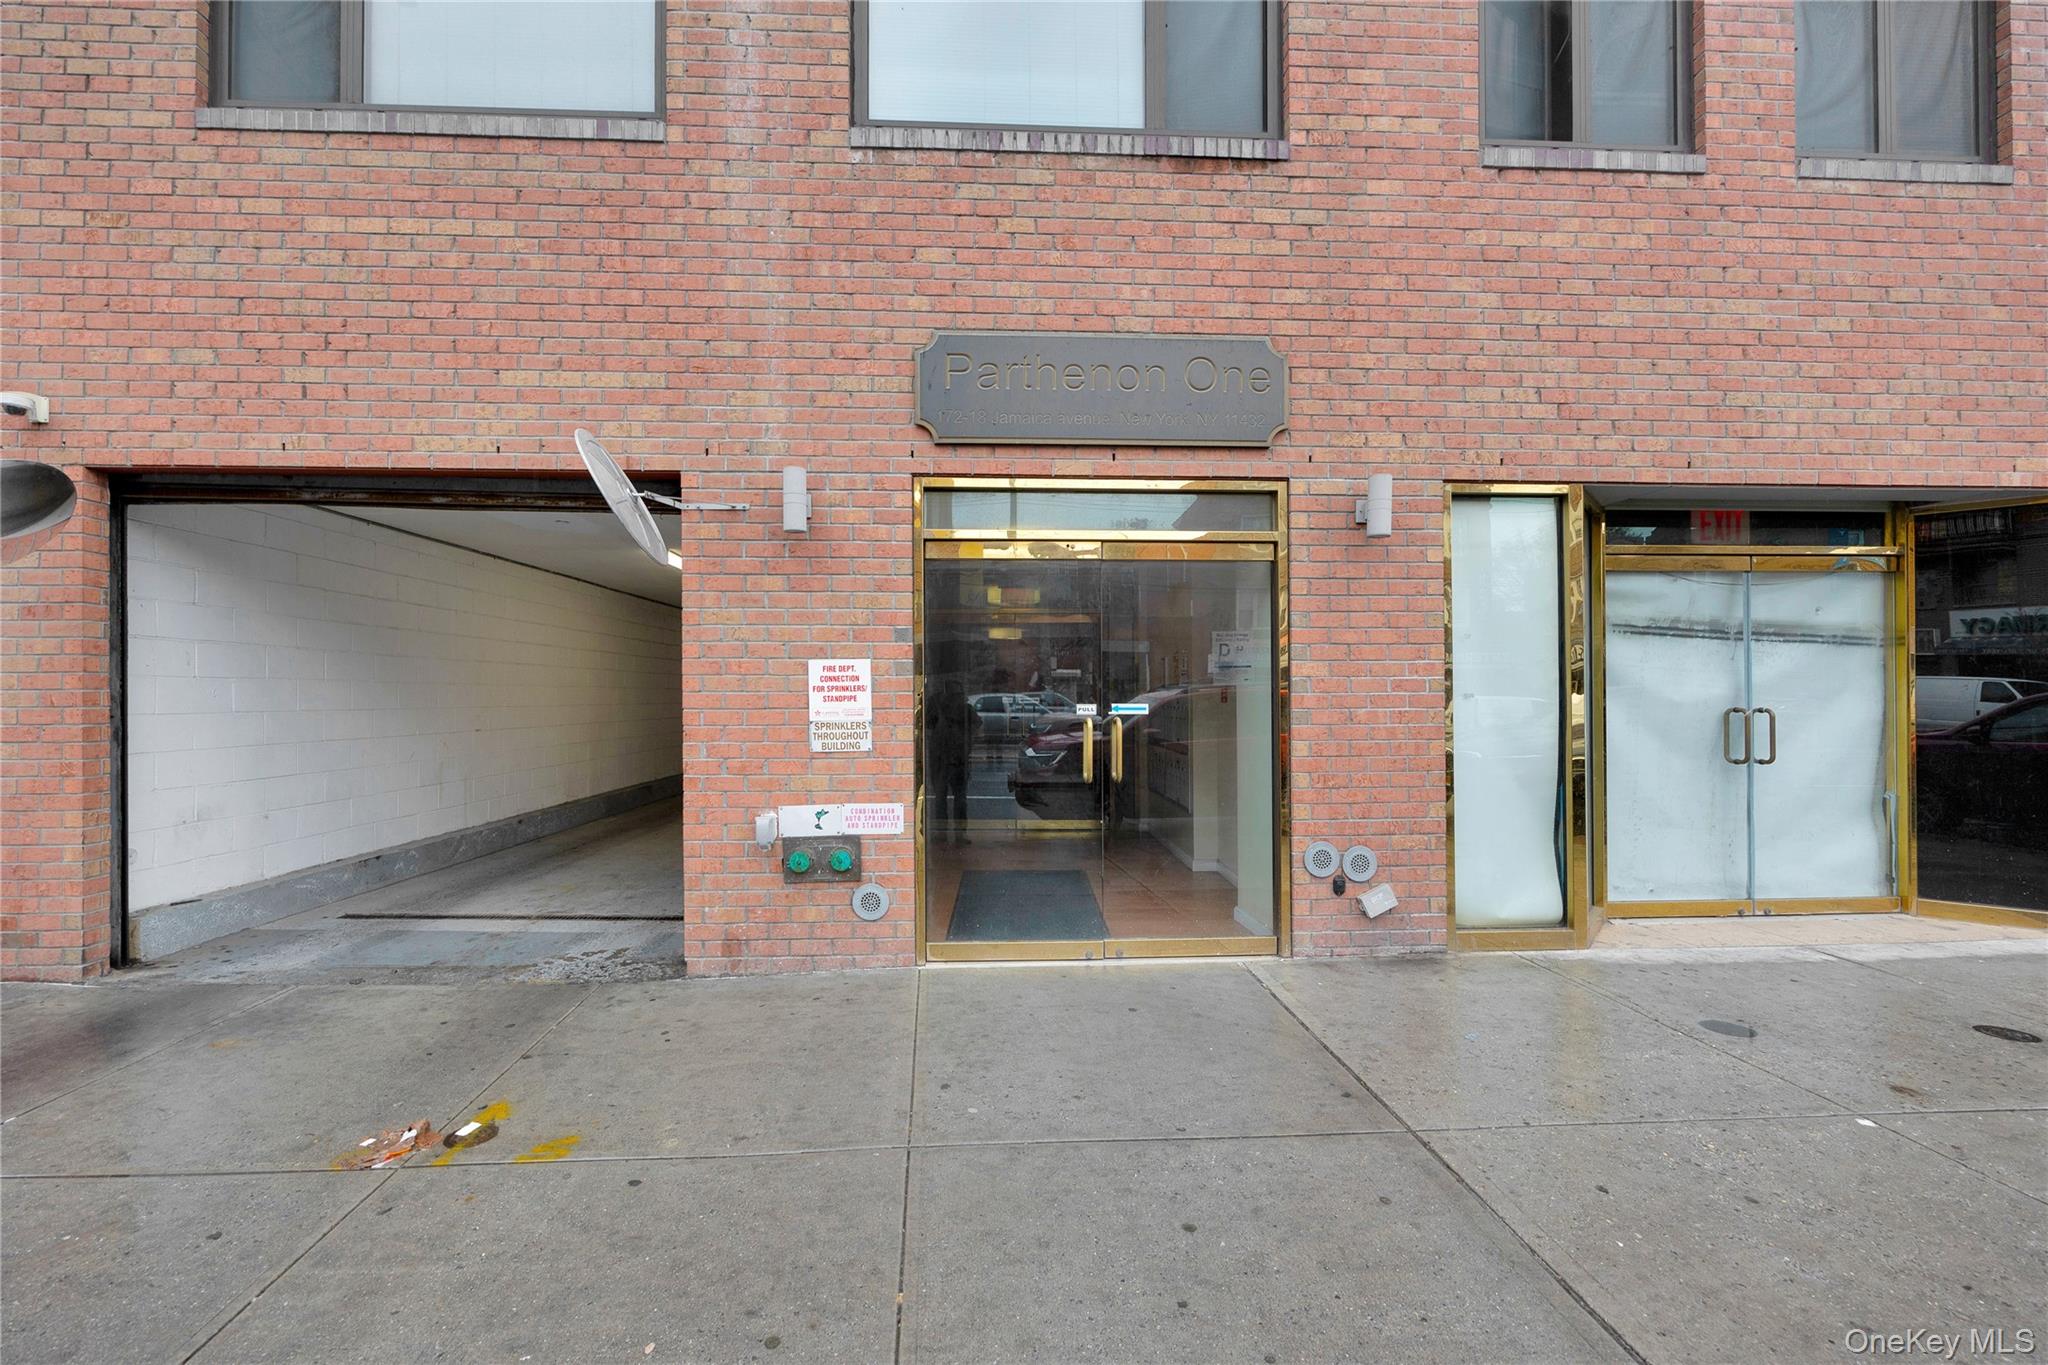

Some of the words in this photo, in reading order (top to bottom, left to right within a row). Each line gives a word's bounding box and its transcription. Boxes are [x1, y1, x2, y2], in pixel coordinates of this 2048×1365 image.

[943, 352, 1168, 392] Parthenon
[1184, 356, 1273, 394] One
[937, 409, 986, 425] 172-18
[991, 409, 1052, 425] Jamaica
[1120, 409, 1152, 426] New
[1700, 510, 1744, 541] EXIT
[820, 675, 860, 683] CONNECTION
[812, 685, 825, 693] FOR
[822, 695, 858, 703] STANDPIPE
[814, 721, 867, 731] SPRINKLERS
[812, 731, 869, 741] THROUGHOUT
[821, 741, 861, 751] BUILDING
